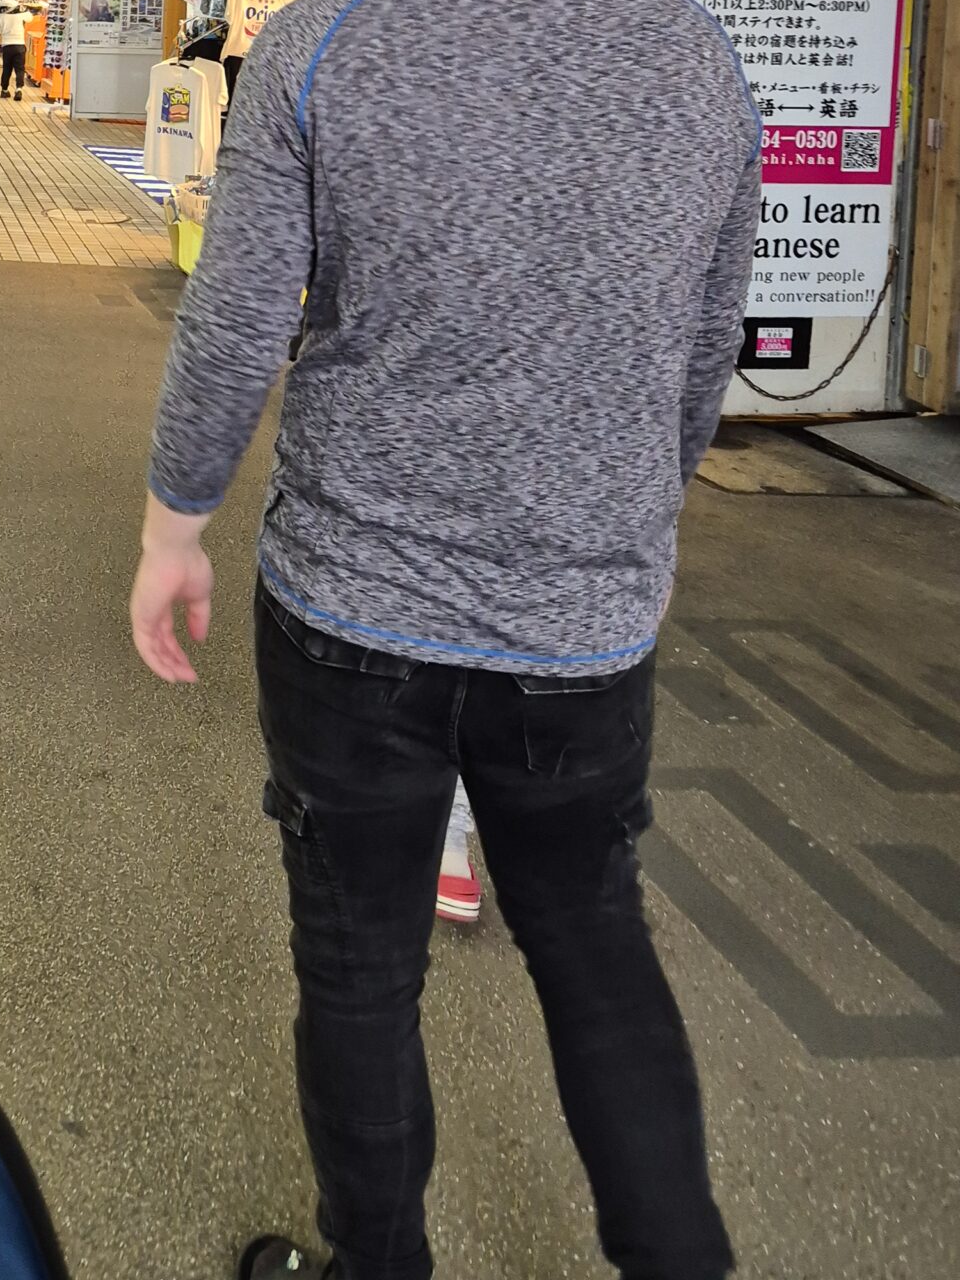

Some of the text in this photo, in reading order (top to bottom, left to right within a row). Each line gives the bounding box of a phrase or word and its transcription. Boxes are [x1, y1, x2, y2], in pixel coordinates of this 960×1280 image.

[819, 98, 859, 119] 英語
[157, 126, 194, 140] OKINAWA
[760, 194, 881, 224] to learn
[753, 237, 841, 259] anese
[780, 271, 810, 282] new
[817, 269, 866, 284] people
[755, 293, 763, 302] a
[770, 289, 876, 303] conversation!!
